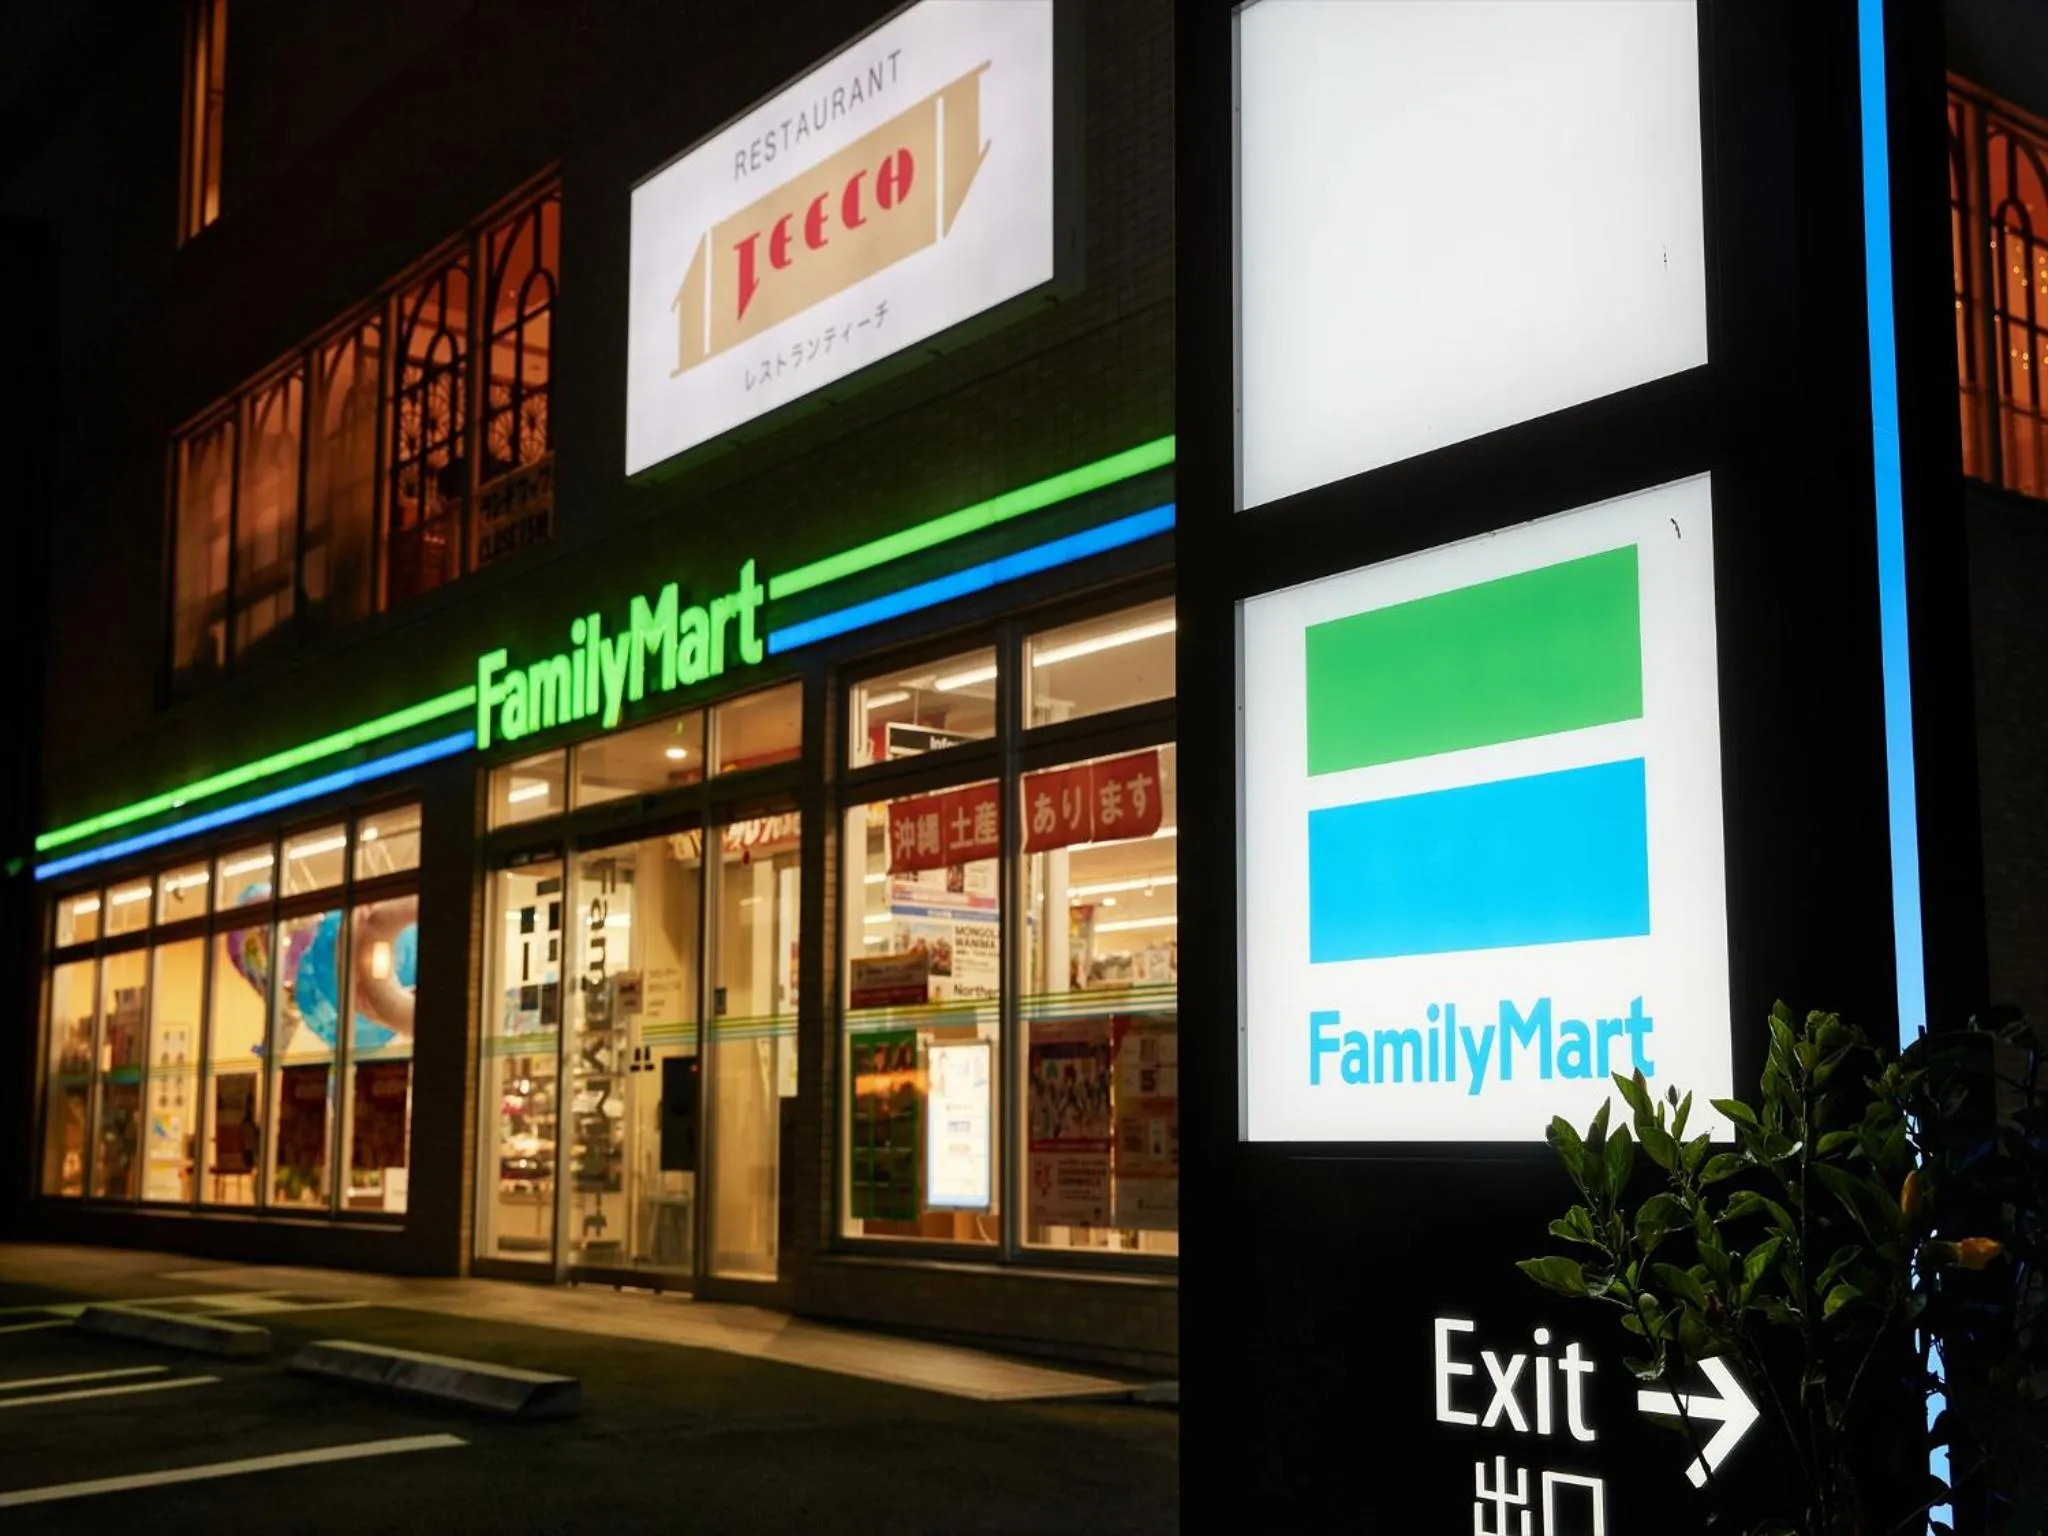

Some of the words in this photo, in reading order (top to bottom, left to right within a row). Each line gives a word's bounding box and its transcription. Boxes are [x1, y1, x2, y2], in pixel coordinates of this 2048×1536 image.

[734, 48, 902, 182] RESTAURANT
[745, 299, 888, 391] レストランティーチ
[477, 558, 764, 750] FamilyMart
[1033, 772, 1153, 834] あります
[1308, 996, 1656, 1096] FamilyMart
[1434, 1317, 1597, 1442] Exit
[1473, 1455, 1606, 1536] 出口
